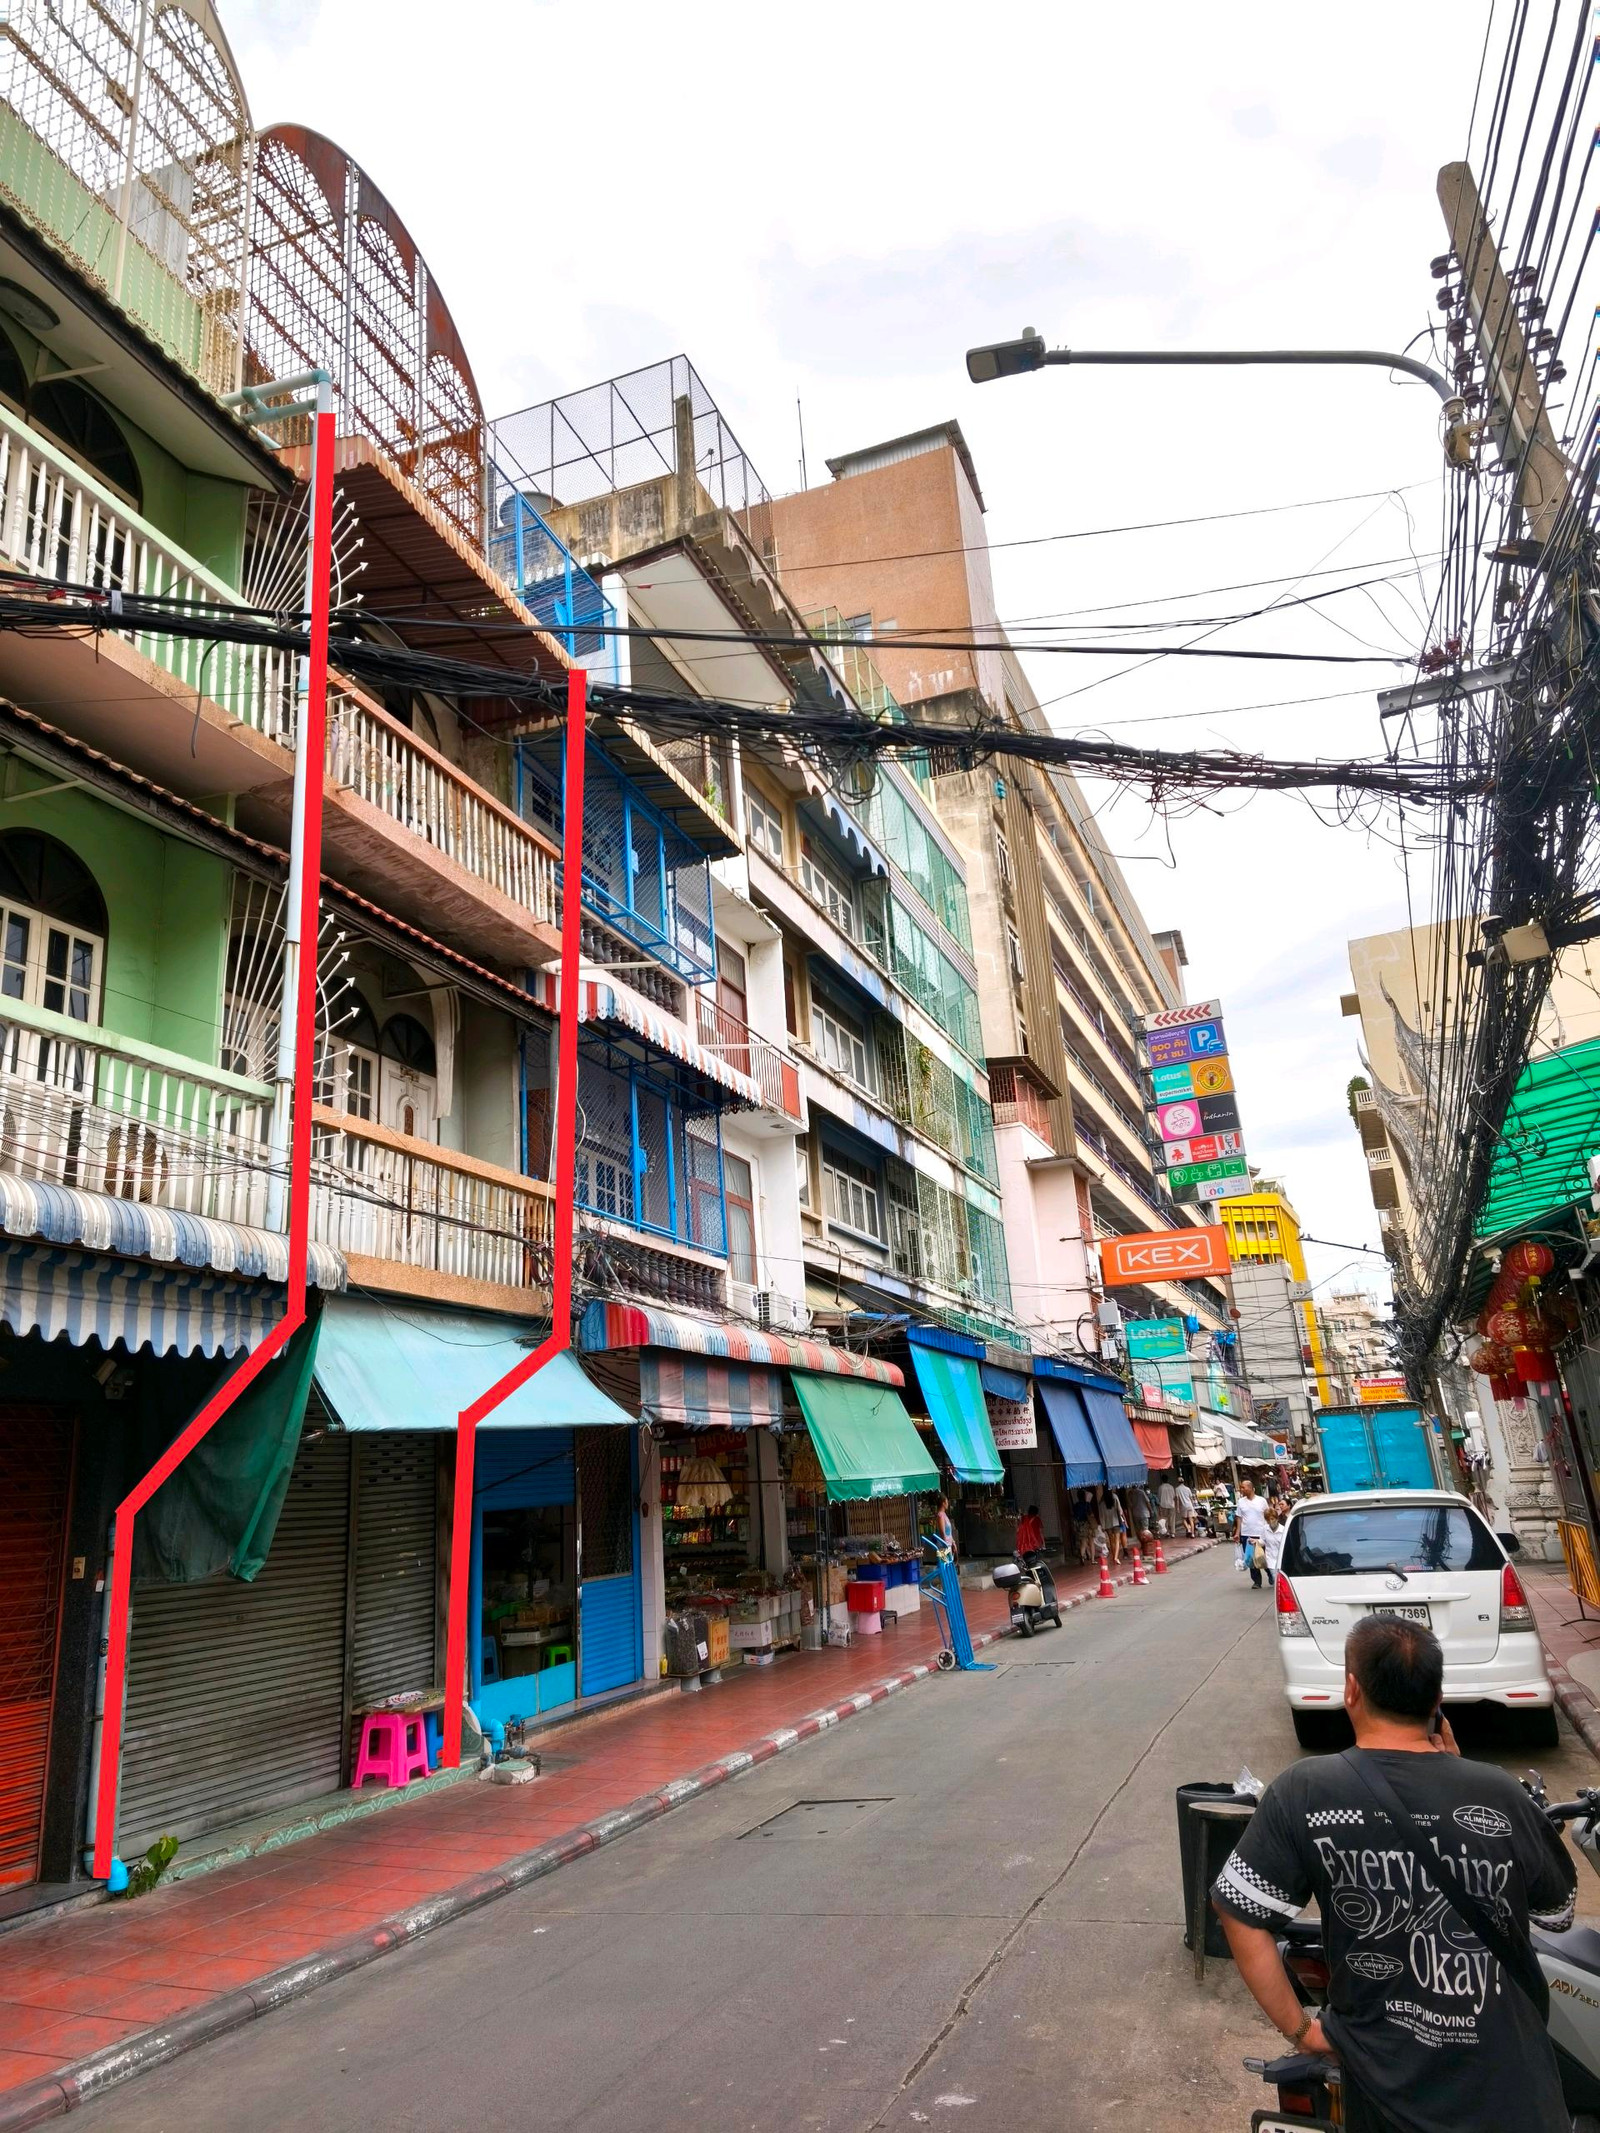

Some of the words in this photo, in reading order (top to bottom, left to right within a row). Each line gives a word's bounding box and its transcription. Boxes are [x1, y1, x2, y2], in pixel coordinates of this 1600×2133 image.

[1197, 1029, 1211, 1047] P
[1151, 1043, 1171, 1052] 800
[1155, 1052, 1168, 1061] 24
[1159, 1087, 1193, 1098] supermarket
[1224, 1148, 1239, 1156] KFC
[1127, 1243, 1201, 1267] KEX
[1400, 1608, 1427, 1620] 7369
[1409, 1813, 1430, 1821] ORLD
[1463, 1814, 1507, 1829] ALIMWEAR
[1354, 1960, 1395, 1971] ALIMWEAR
[1549, 1978, 1581, 1997] ADV
[1428, 2028, 1446, 2037] ABOUT
[1430, 2035, 1443, 2043] GOD
